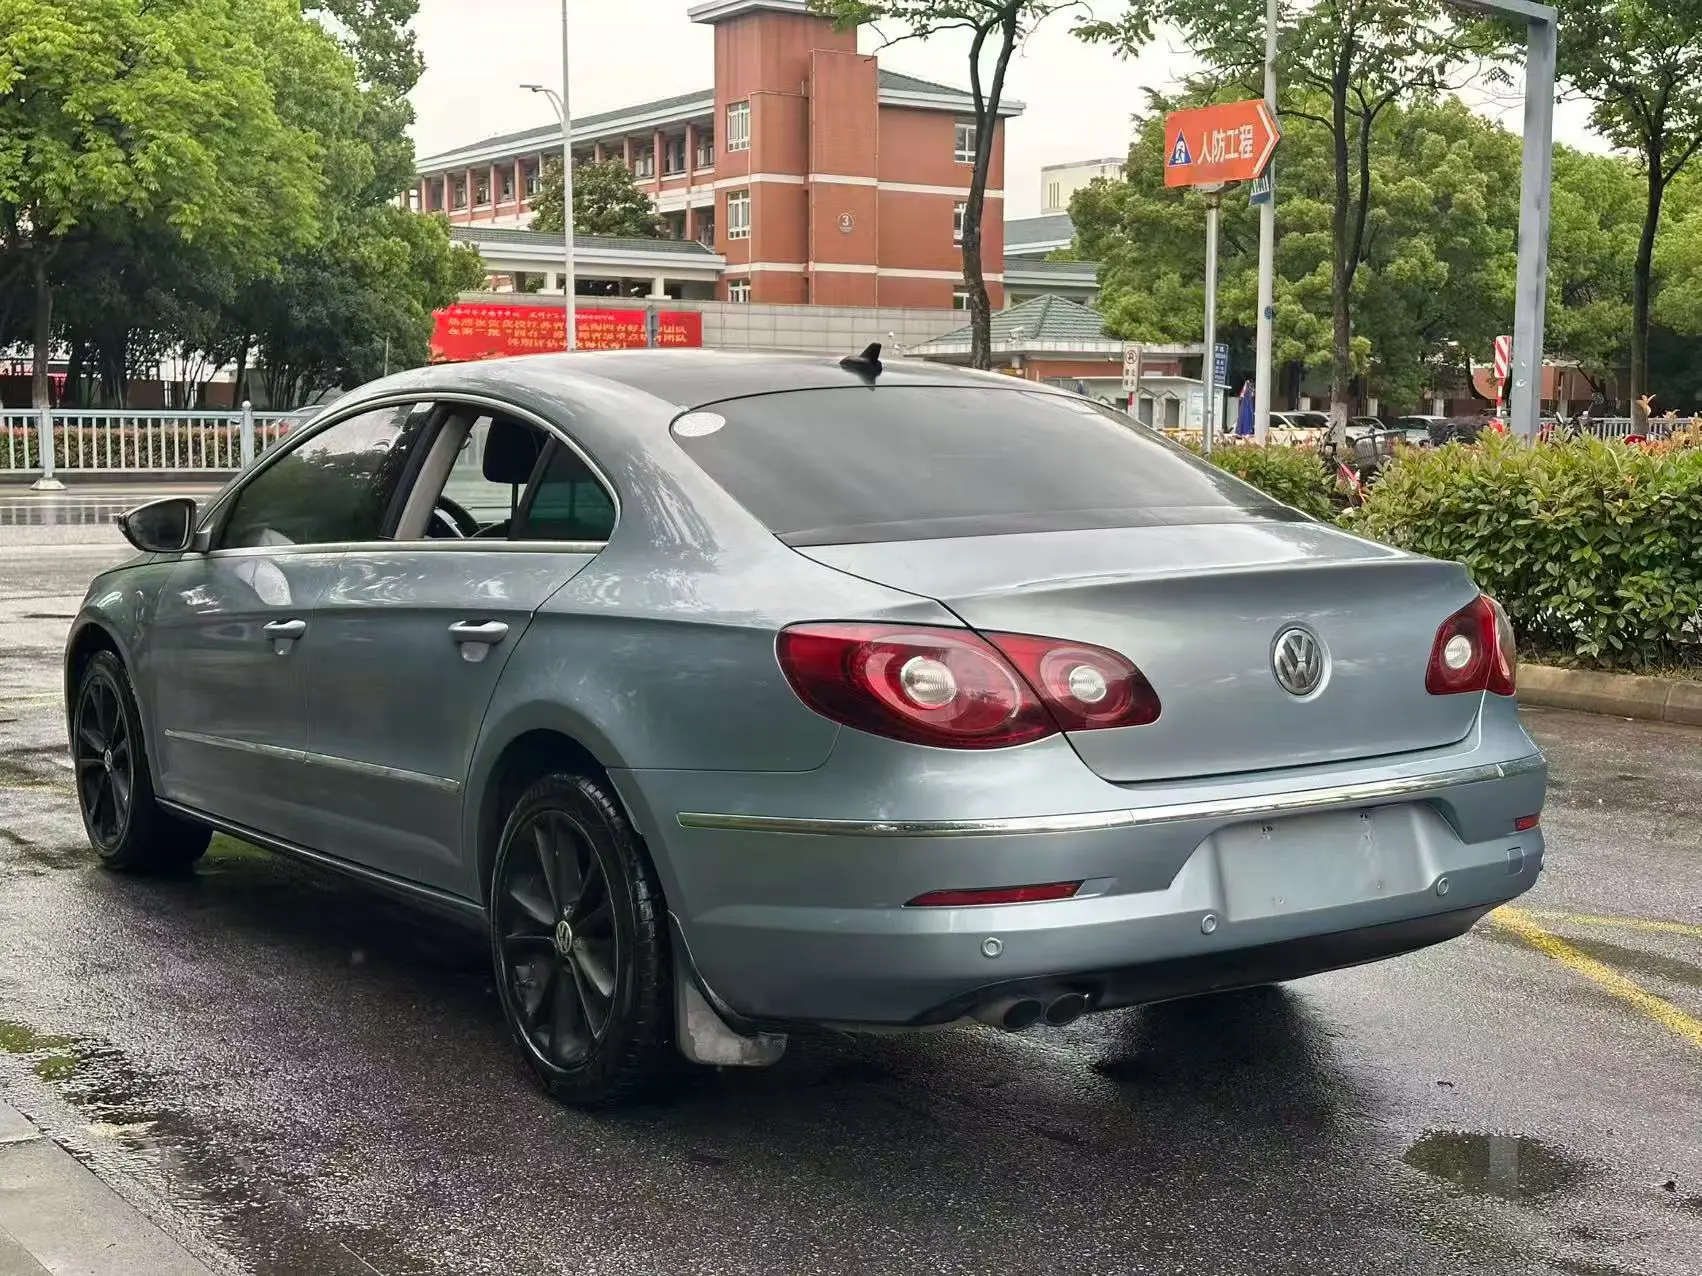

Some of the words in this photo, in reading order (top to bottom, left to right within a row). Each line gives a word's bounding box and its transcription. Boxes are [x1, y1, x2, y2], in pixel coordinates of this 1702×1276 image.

[1197, 125, 1254, 164] 人防工程
[842, 215, 849, 226] 3
